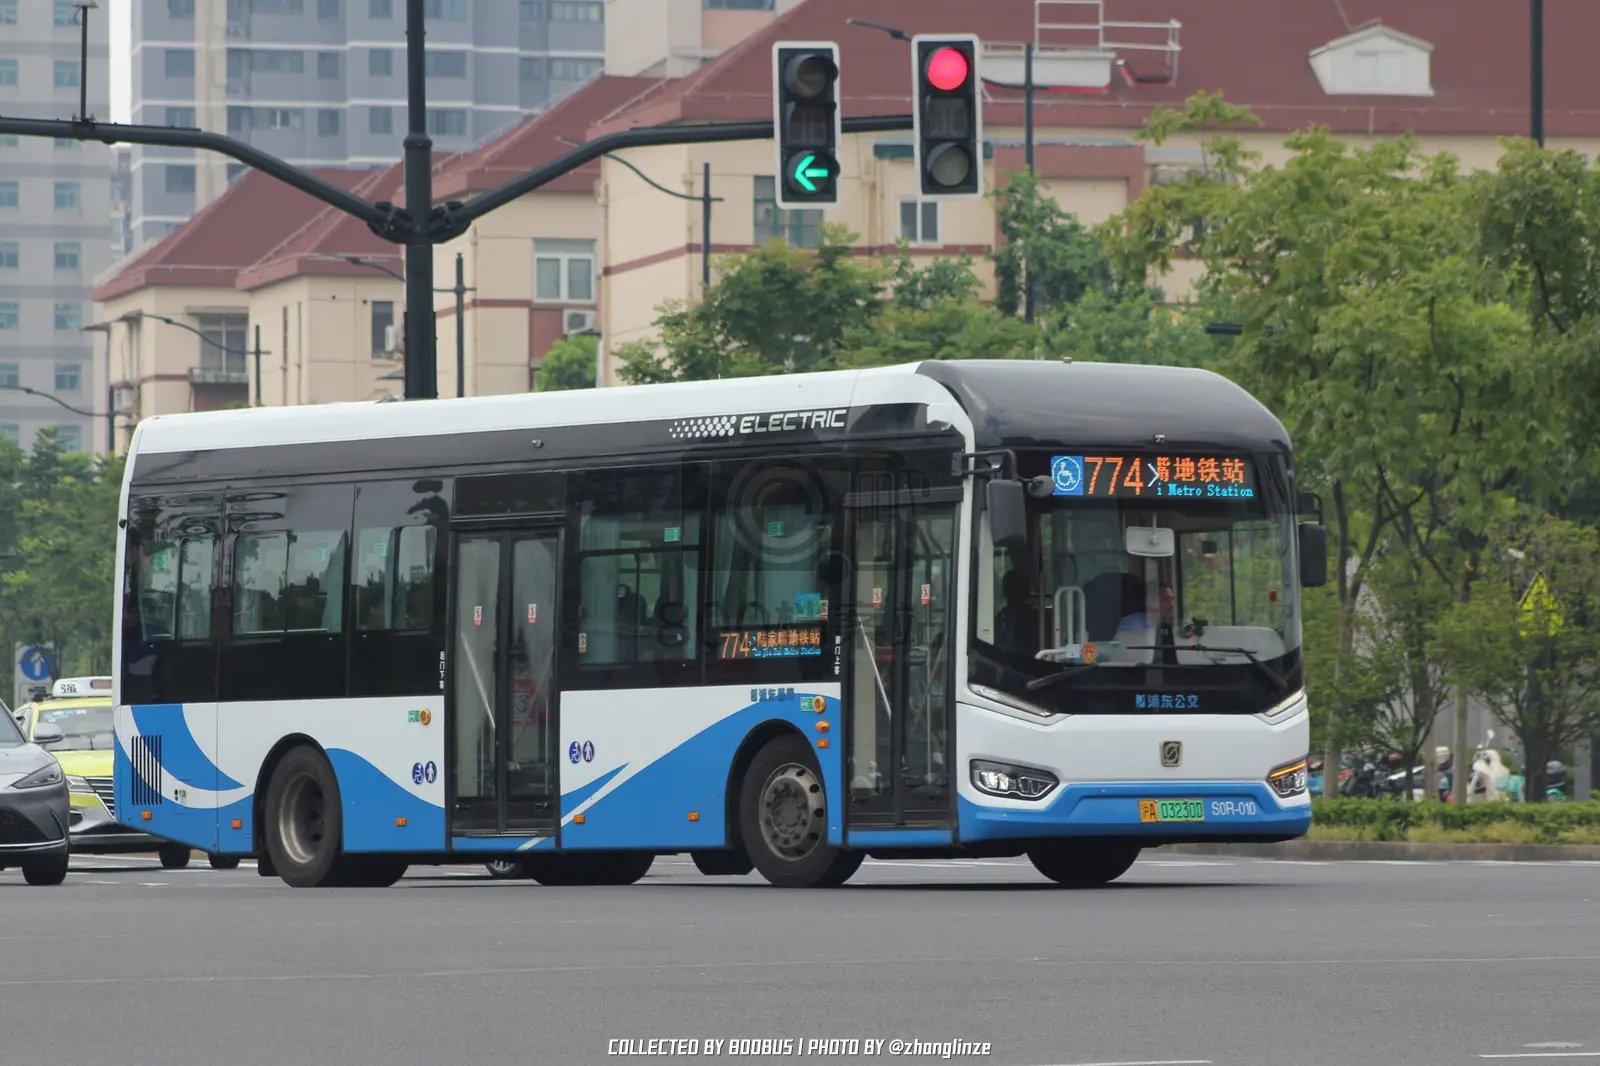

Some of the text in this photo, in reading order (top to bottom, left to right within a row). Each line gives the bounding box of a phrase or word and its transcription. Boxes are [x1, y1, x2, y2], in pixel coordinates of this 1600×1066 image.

[740, 409, 847, 433] ELECTRIC
[1084, 456, 1144, 495] 774
[1168, 483, 1202, 496] Metro
[1207, 484, 1254, 497] Station
[720, 631, 749, 659] 774
[1147, 694, 1199, 708] 浦东公交
[1161, 802, 1203, 819] 03230D
